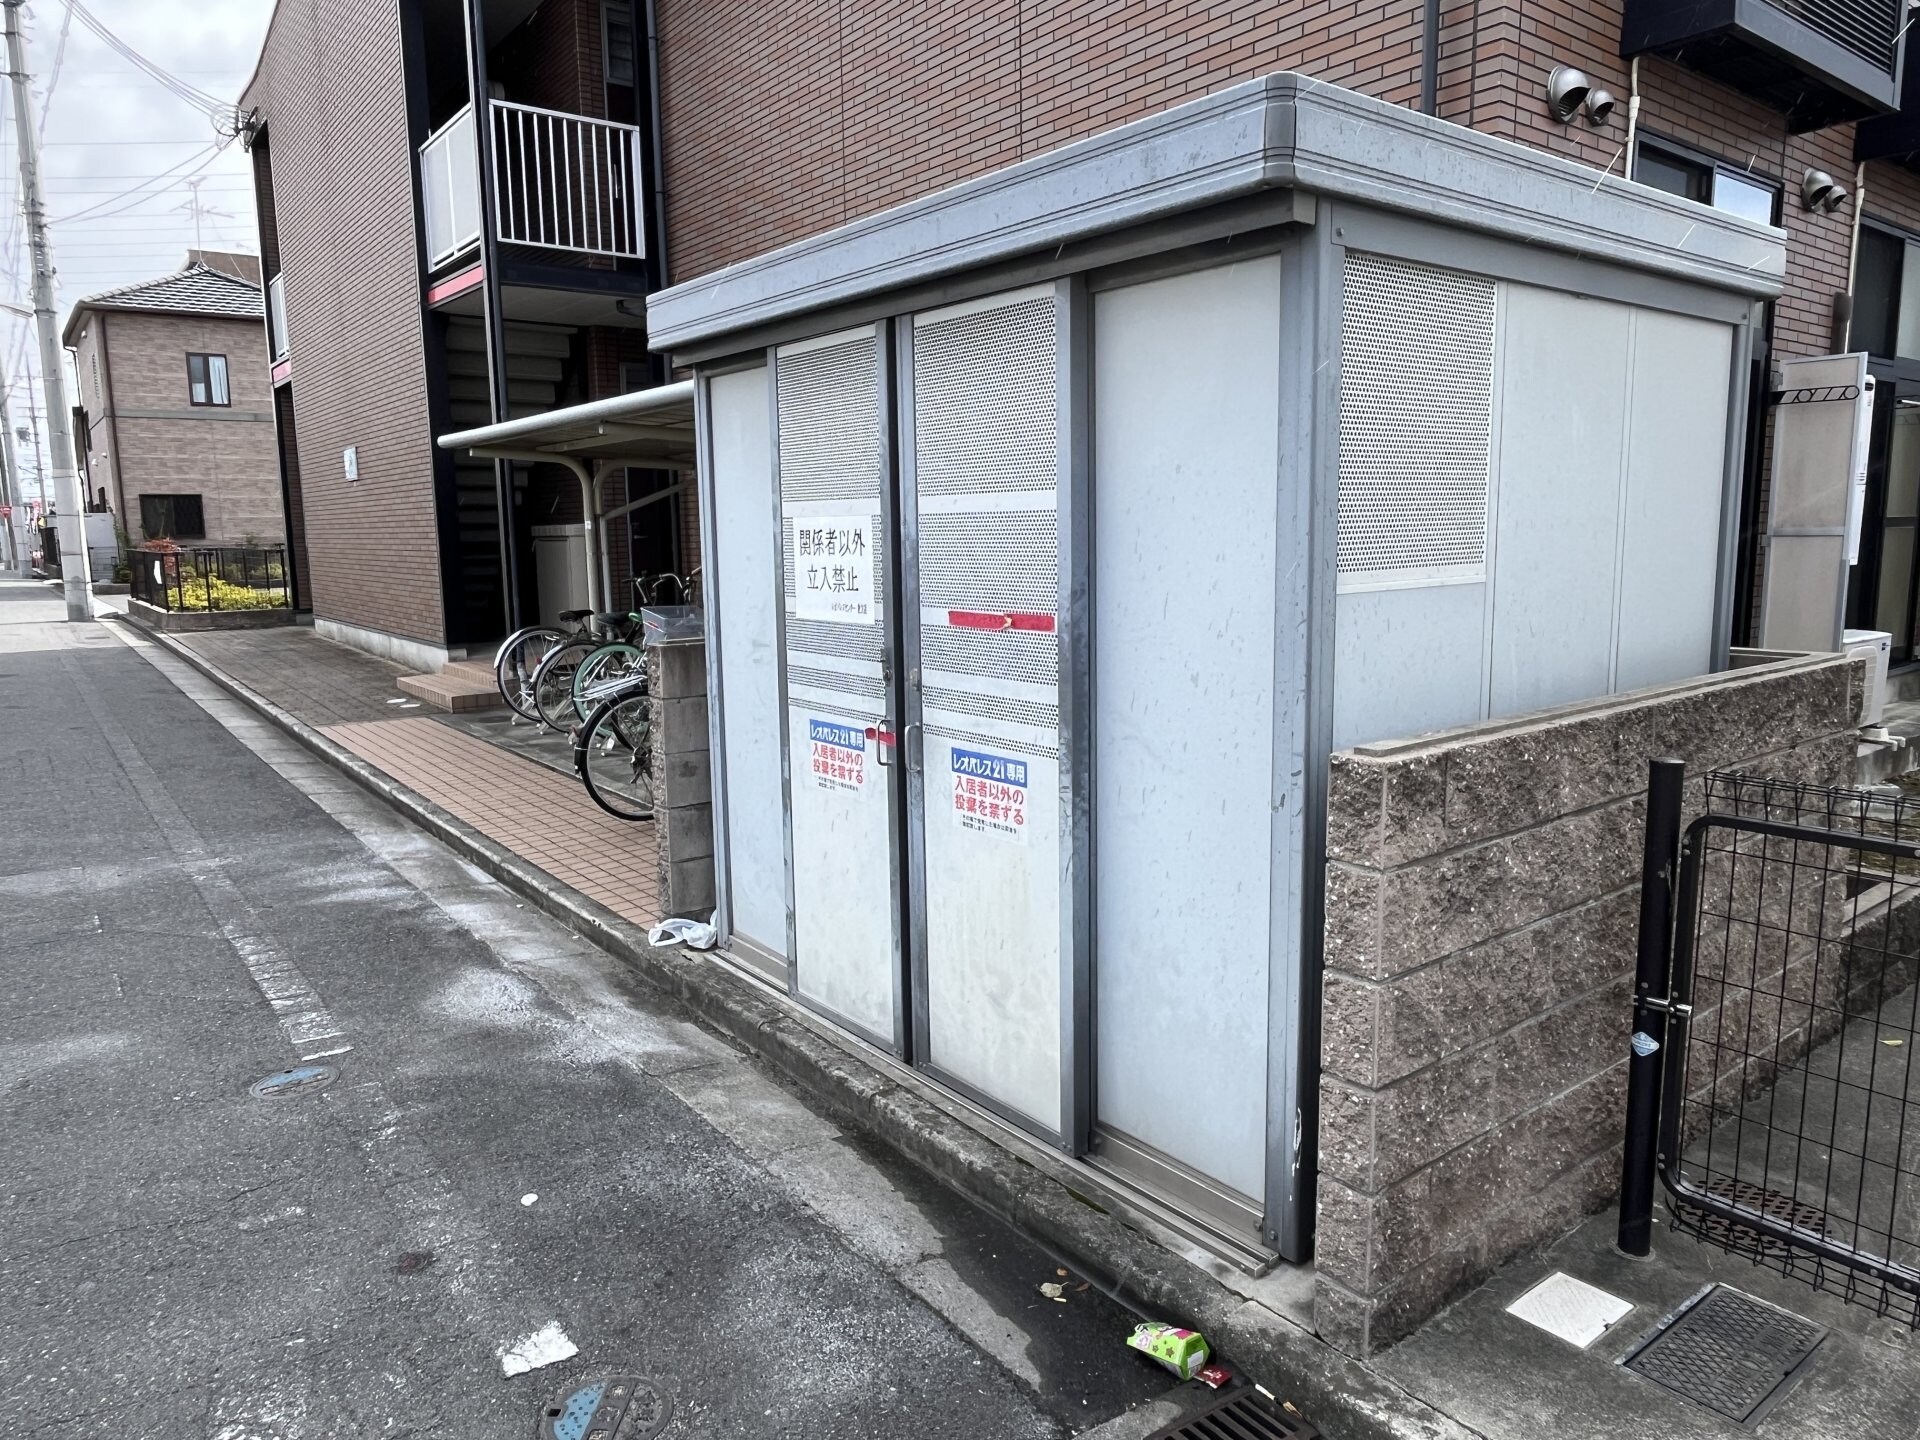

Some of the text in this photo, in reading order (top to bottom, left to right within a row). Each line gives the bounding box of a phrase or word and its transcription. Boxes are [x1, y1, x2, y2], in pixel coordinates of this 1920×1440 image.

[799, 527, 866, 557] 関係者以外
[807, 563, 860, 593] 立入禁止
[812, 742, 864, 766] 入居者以外の
[954, 774, 1025, 805] 入居者以外の
[954, 793, 1025, 826] 投棄を禁ずる
